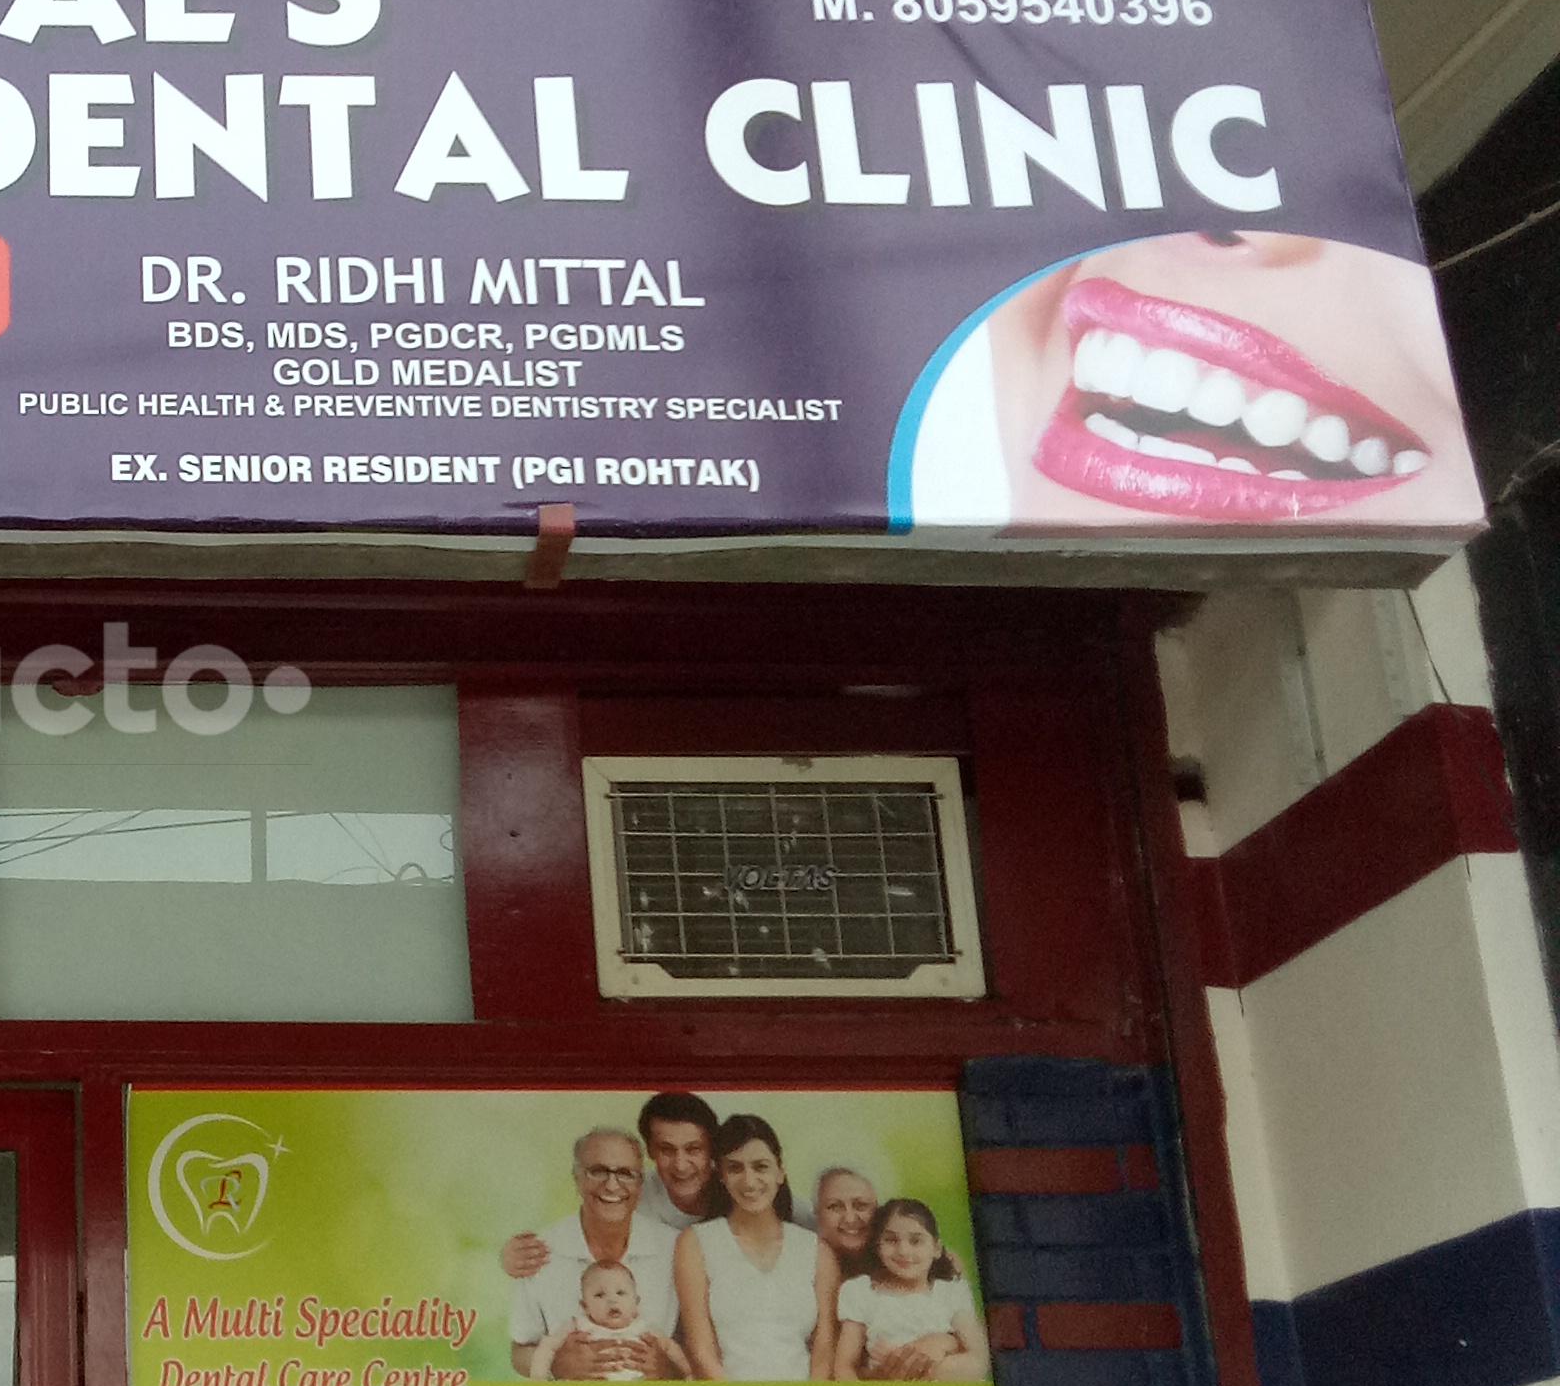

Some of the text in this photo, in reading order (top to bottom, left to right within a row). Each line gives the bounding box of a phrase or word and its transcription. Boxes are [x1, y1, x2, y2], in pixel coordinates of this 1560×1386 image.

[705, 79, 1281, 212] CLINIC
[143, 256, 705, 306] DR. RIDHI MITTAL
[169, 322, 684, 354] BDS, MDS, PGDCR, PGDMLS
[274, 359, 582, 386] GOLD MEDALIST
[20, 394, 842, 420] PUBLIC HEALTH & PREVENTIVE DENTISTRY SPECIALIST
[112, 455, 759, 492] EX. SENIOR RESIDENT (PGI ROHTAK)
[143, 1296, 478, 1348] A Multi Speciality
